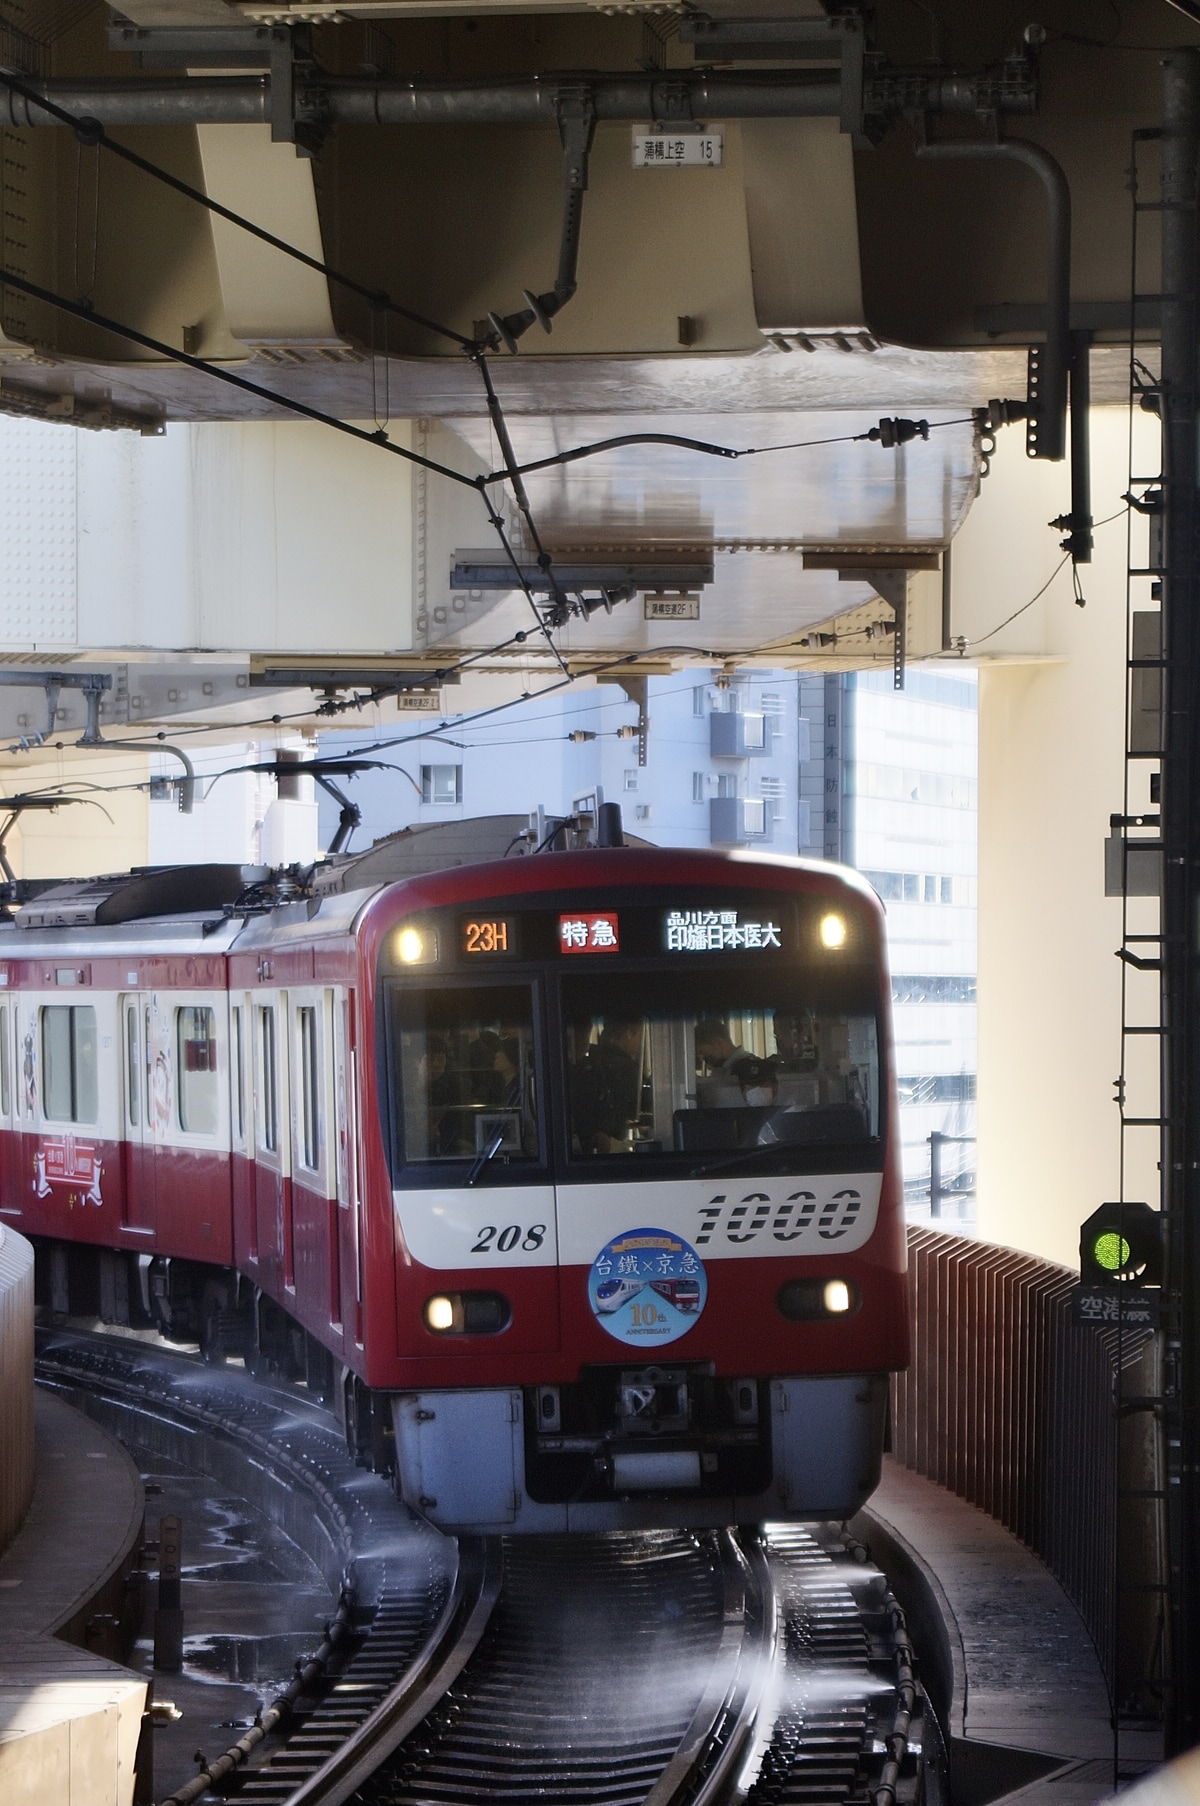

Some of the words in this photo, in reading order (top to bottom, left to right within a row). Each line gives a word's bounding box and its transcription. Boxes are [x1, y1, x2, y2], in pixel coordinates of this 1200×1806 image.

[700, 140, 713, 159] 15
[667, 911, 738, 926] 品川方面
[466, 922, 507, 952] 23H
[562, 920, 617, 947] 特急
[667, 922, 782, 950] 印旛日本医大
[695, 1189, 862, 1244] 1000
[471, 1224, 547, 1253] 208
[626, 1328, 671, 1336] ANNIVERSARY
